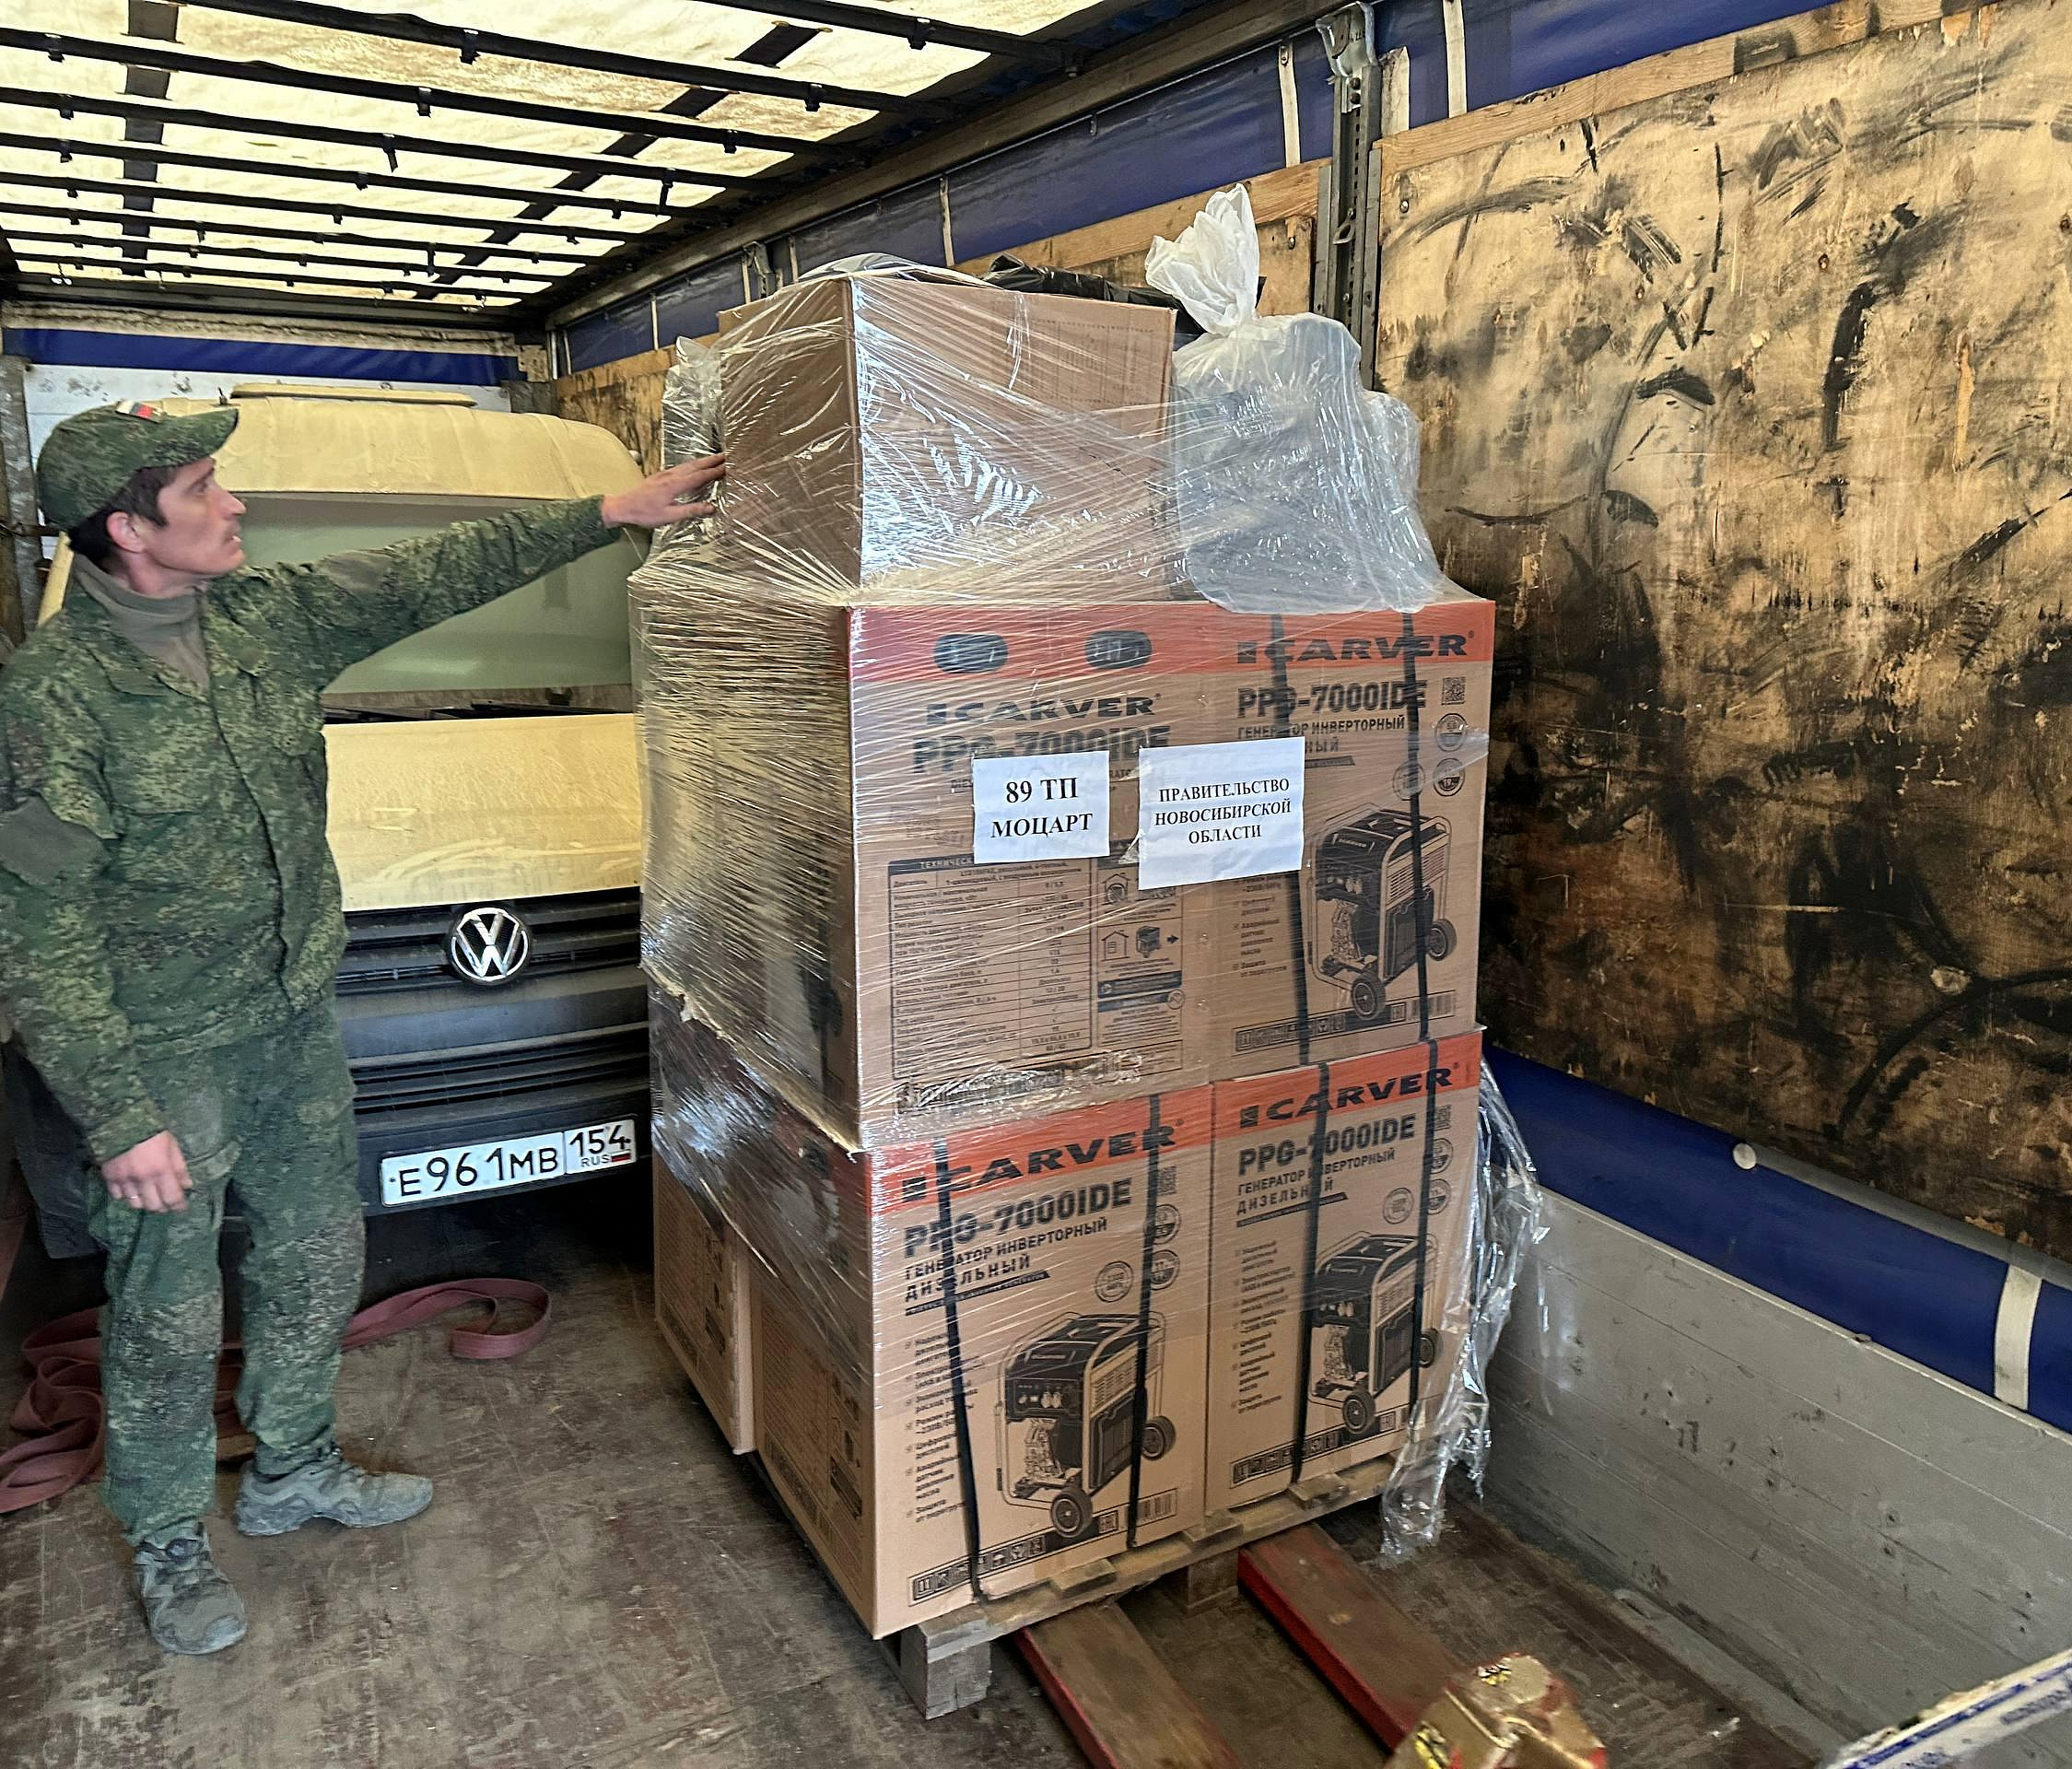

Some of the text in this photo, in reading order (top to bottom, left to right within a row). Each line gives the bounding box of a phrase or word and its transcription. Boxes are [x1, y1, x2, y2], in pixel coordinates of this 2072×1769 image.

[1264, 635, 1468, 661] CARVER
[954, 697, 1155, 721] CARVER
[1312, 715, 1406, 734] ИНВЕРТОРНЫЙ
[1006, 777, 1079, 803] 89 ТП
[1159, 778, 1290, 802] ПРАВИТЕЛЬСТВО
[990, 813, 1094, 838] МОЦАРТ
[1155, 798, 1291, 827] НОВОСИБИРСКОЙ
[1188, 825, 1261, 844] ОБЛАСТИ
[1266, 1068, 1454, 1120] CARVER
[569, 1125, 626, 1157] 154
[581, 1153, 610, 1167] RUS
[936, 1126, 1176, 1191] CARVER
[1237, 1147, 1396, 1196] ГЕНЕРАТОР ВЕРТОРНЫЙ
[1236, 1177, 1333, 1215] ДИЗЕЛЬНЙ
[906, 1247, 993, 1280] ГЕНЕАТОР
[997, 1216, 1108, 1257] ИНВЕРТОРНЫЙ
[905, 1253, 1031, 1302] ДИЗЛЬНЫЙ
